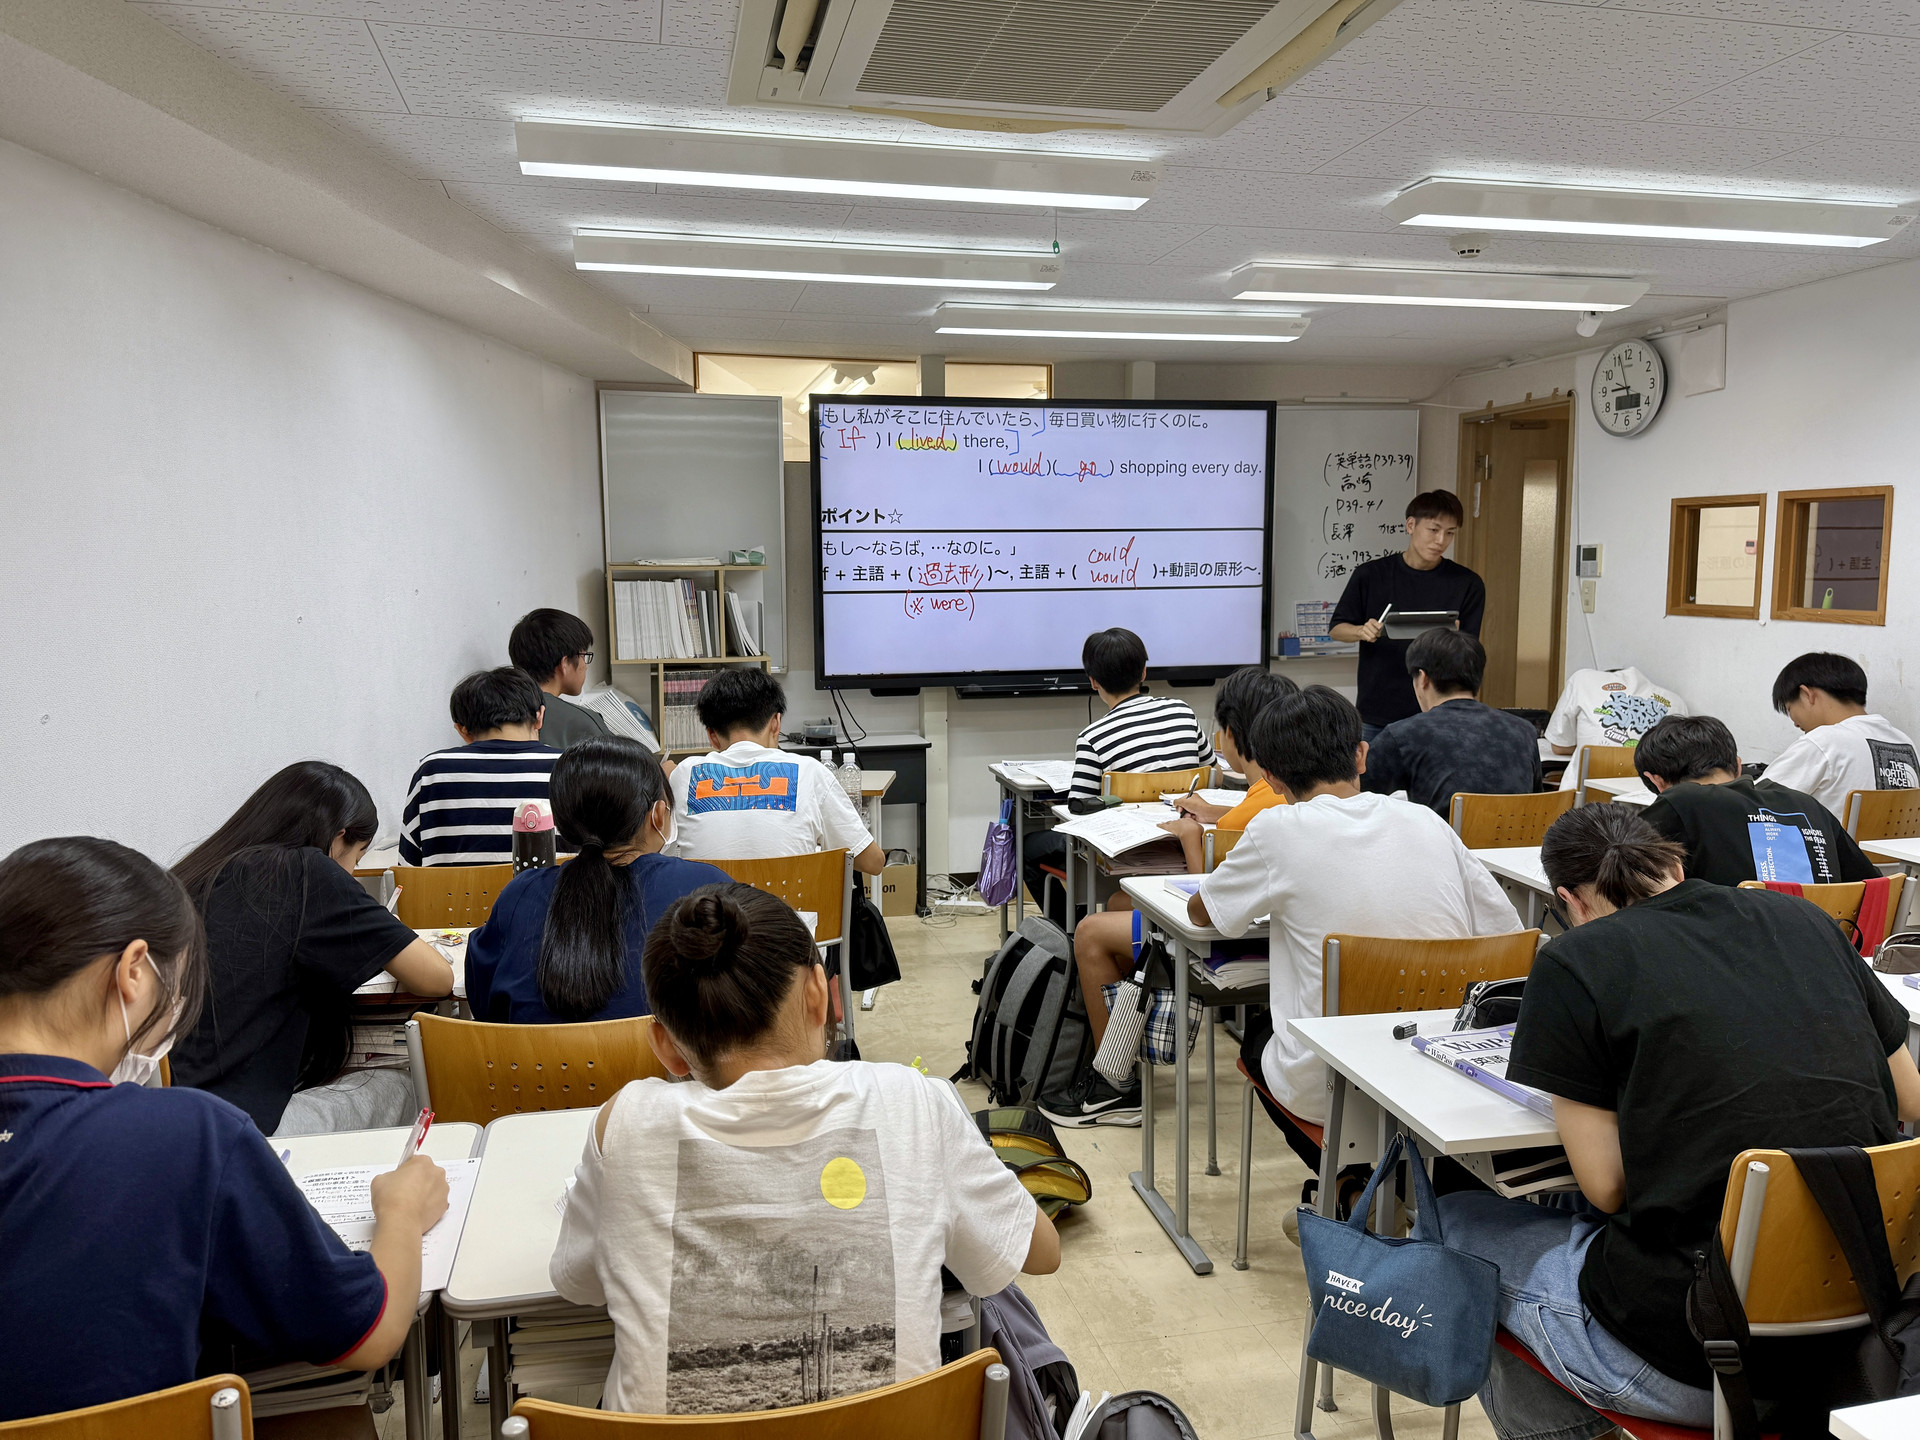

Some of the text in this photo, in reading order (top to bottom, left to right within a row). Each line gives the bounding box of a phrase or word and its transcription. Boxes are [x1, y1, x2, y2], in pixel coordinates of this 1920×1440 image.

[1624, 349, 1632, 360] 12
[1639, 351, 1642, 362] 1
[1646, 361, 1651, 372] 2
[1605, 369, 1613, 381] 10
[1649, 377, 1655, 389] 3
[1602, 386, 1607, 397] 9
[1605, 402, 1610, 413] 8
[1645, 396, 1650, 407] 4
[1613, 413, 1618, 425] 7
[1636, 409, 1641, 420] 5
[1624, 415, 1630, 427] 6
[963, 433, 1009, 450] there,
[1119, 460, 1187, 477] shopping
[1191, 463, 1230, 477] every
[1233, 460, 1262, 477] day.
[1087, 536, 1136, 567] could
[852, 565, 884, 582] 主語
[1019, 563, 1050, 581] 主語
[1889, 760, 1905, 771] THE
[1879, 767, 1907, 779] NORTH
[1887, 776, 1908, 787] FACE
[1330, 1274, 1358, 1290] HAVE A
[1323, 1291, 1419, 1339] nice day
